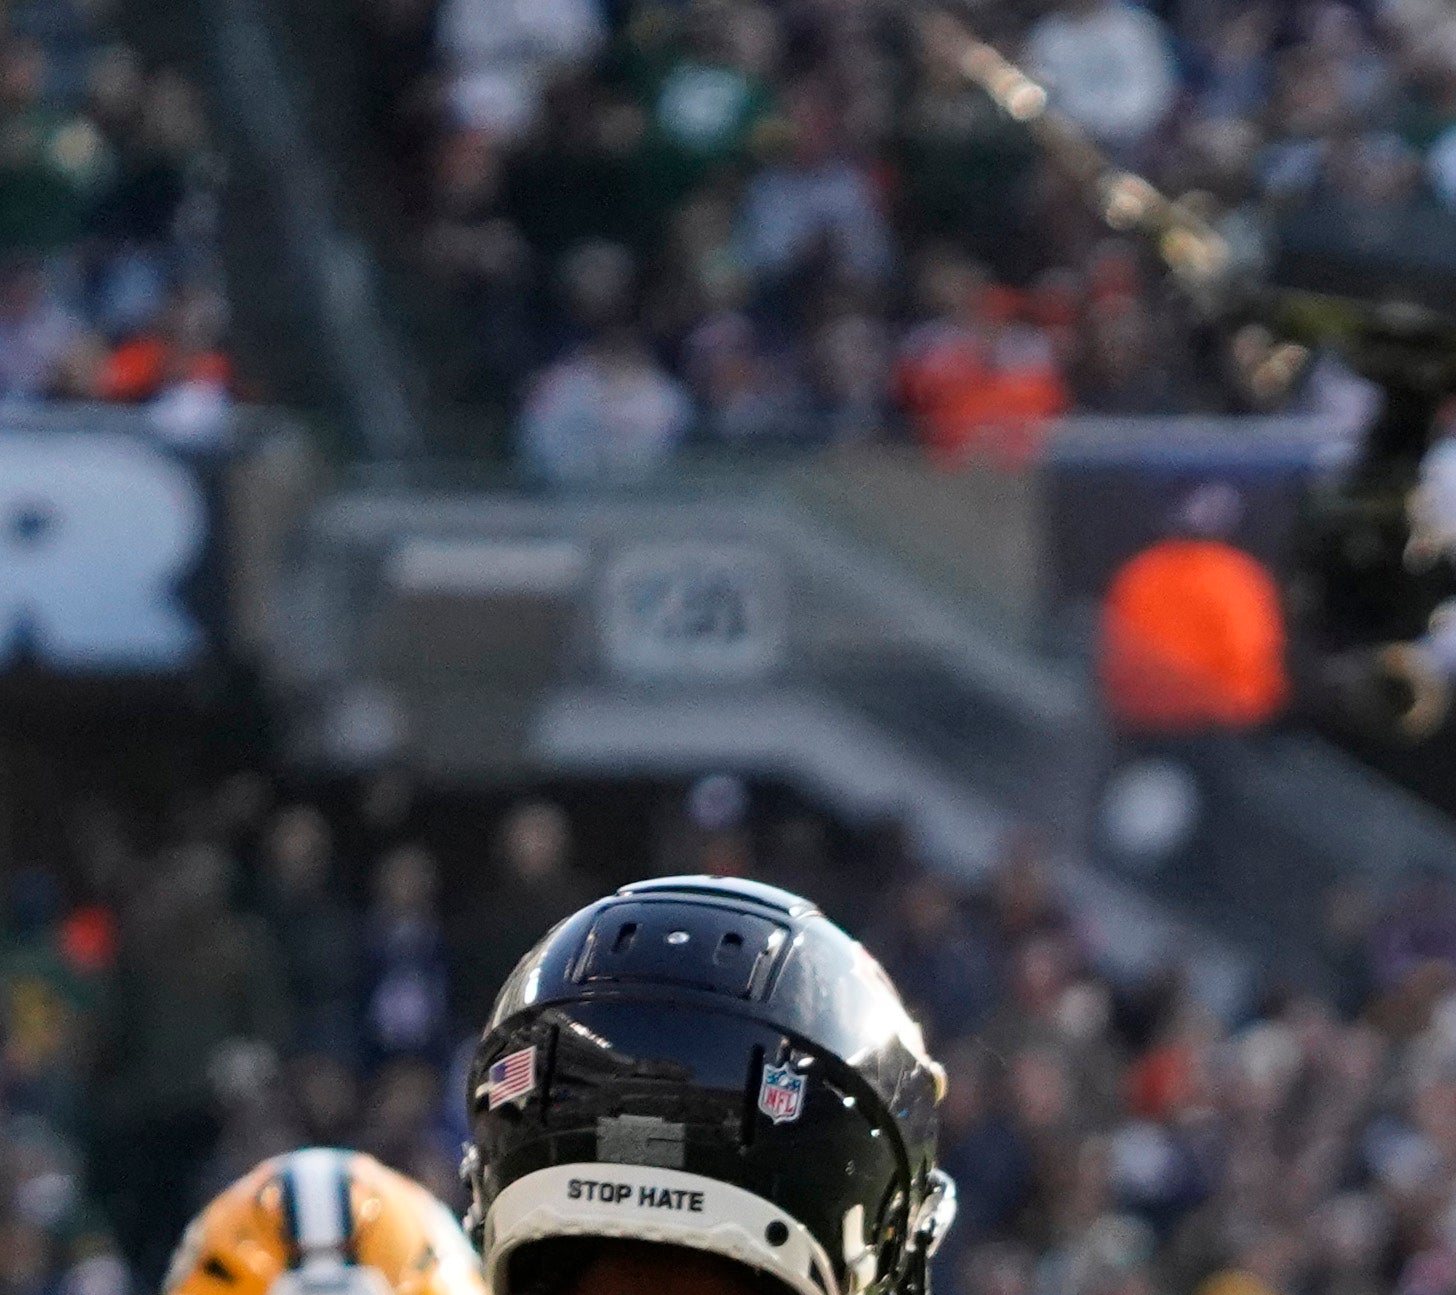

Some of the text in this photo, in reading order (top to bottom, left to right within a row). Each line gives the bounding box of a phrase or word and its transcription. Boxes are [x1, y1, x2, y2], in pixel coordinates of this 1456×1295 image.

[764, 1086, 797, 1115] NFL
[567, 1178, 706, 1212] STOP HATE
